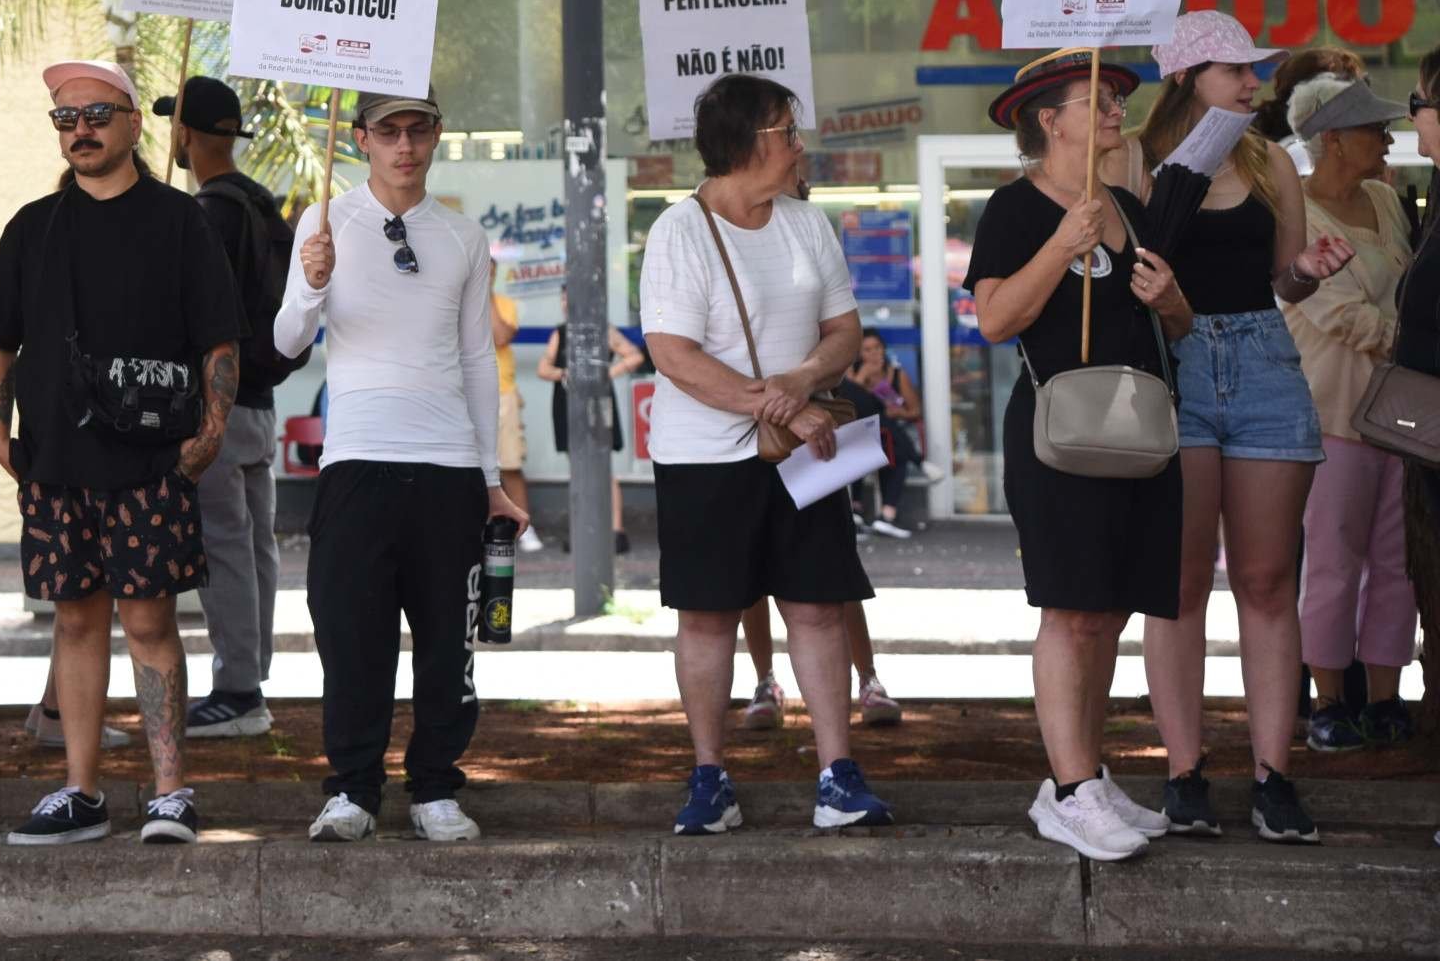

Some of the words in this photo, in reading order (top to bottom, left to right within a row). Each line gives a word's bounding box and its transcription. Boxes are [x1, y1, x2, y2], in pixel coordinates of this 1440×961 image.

[338, 40, 369, 48] CSP
[262, 54, 294, 64] Sindicato
[309, 59, 356, 71] Trabalhadores
[370, 66, 402, 76] Educação
[676, 49, 717, 77] NÃO
[723, 46, 732, 72] É
[738, 44, 784, 71] NÃO!
[268, 64, 285, 72] Rede
[287, 66, 311, 75] Pública
[312, 70, 344, 79] Municipal
[372, 76, 403, 86] Horizonte
[821, 105, 923, 136] ARAUJO
